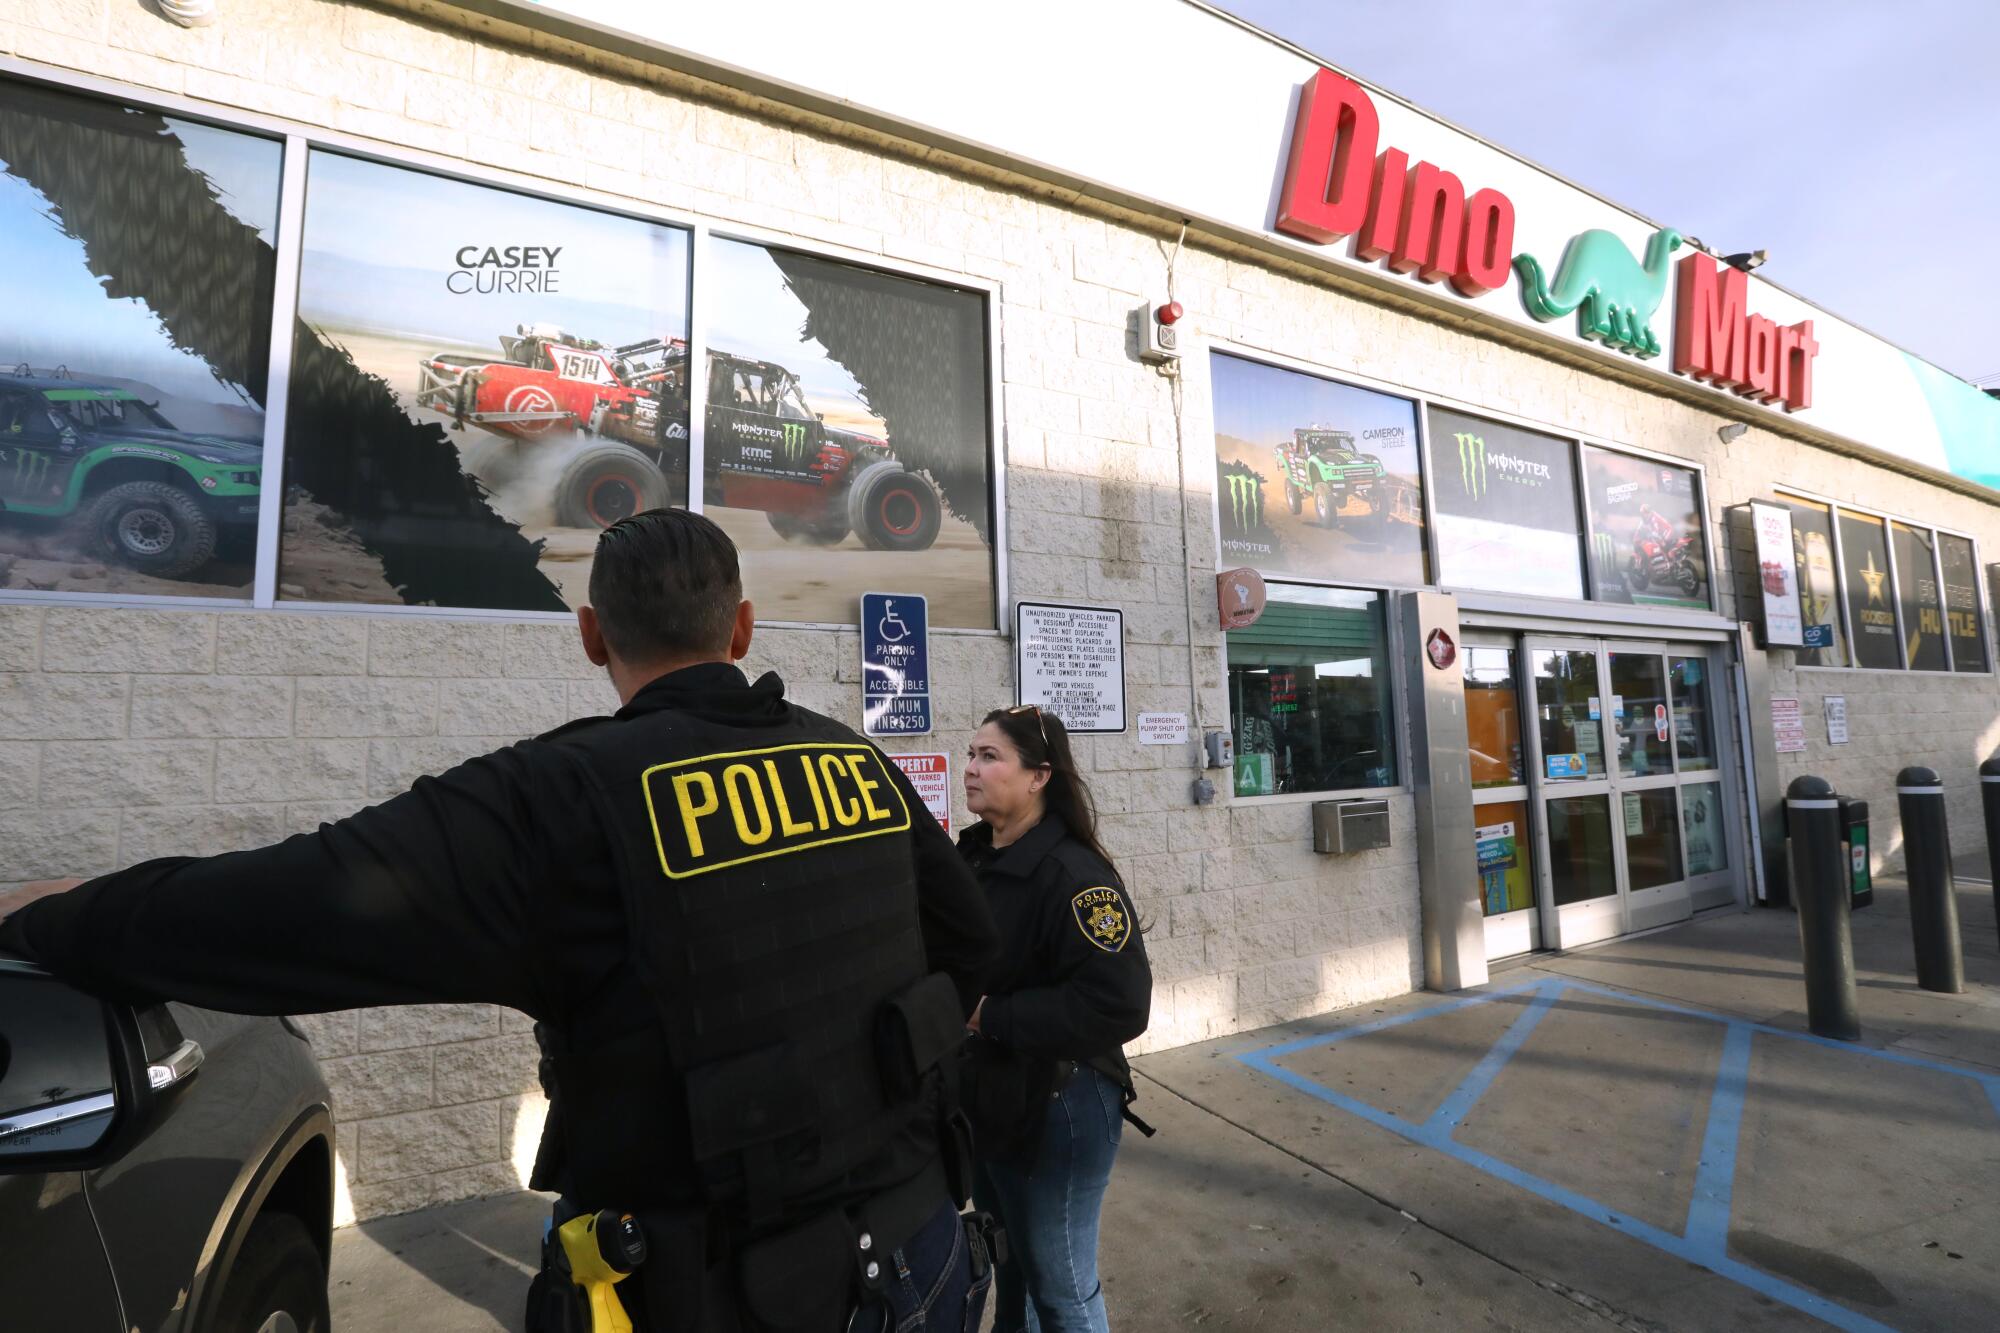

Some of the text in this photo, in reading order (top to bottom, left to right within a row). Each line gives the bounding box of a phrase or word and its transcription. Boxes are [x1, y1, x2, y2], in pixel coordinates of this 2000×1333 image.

[1275, 68, 1819, 413] Dino Mart
[455, 245, 563, 269] CASEY
[446, 270, 560, 294] CURRIE
[563, 354, 600, 380] 1514
[732, 422, 783, 440] MONSTER
[1362, 426, 1404, 440] CAMERON
[1381, 437, 1407, 449] STEELE
[1487, 452, 1551, 479] MONSTER
[1499, 473, 1543, 487] ENERGY
[1222, 539, 1271, 554] MONSTER
[1025, 610, 1066, 619] UNAUTHORIZED
[1068, 612, 1094, 621] VEHICLES
[1919, 607, 1977, 638] HUTLE
[1043, 619, 1075, 628] DESIGNATED
[1077, 621, 1109, 630] ACCESSIBLE
[1038, 627, 1105, 638] SPACES NOT DISPLAYING
[1030, 634, 1112, 646] DISTINGUISHING PLACARDS OR
[876, 645, 915, 655] PARNG
[1026, 643, 1117, 654] SPECIAL LICENSE PLATES ISSUED
[884, 656, 907, 666] ONLY
[1026, 651, 1116, 662] FOR PERSONS WITH DISABILITIES
[1068, 661, 1086, 669] TOWED
[1036, 668, 1043, 676] AT
[1058, 669, 1083, 677] OWNER'S
[1085, 670, 1108, 678] EXPENSE
[869, 680, 925, 690] ACCESSIBLE
[1070, 682, 1095, 690] VEHICLES
[1066, 690, 1094, 698] RECLAIMED
[874, 699, 921, 713] MINIMUM
[899, 715, 925, 731] $250
[1066, 720, 1096, 728] 623-9600
[1243, 716, 1255, 755] IG-ZAG
[891, 758, 935, 772] OPERTY
[1240, 764, 1257, 788] A
[920, 784, 945, 792] VEHICLE
[671, 754, 891, 858] POLICE
[1076, 890, 1119, 908] POLICE
